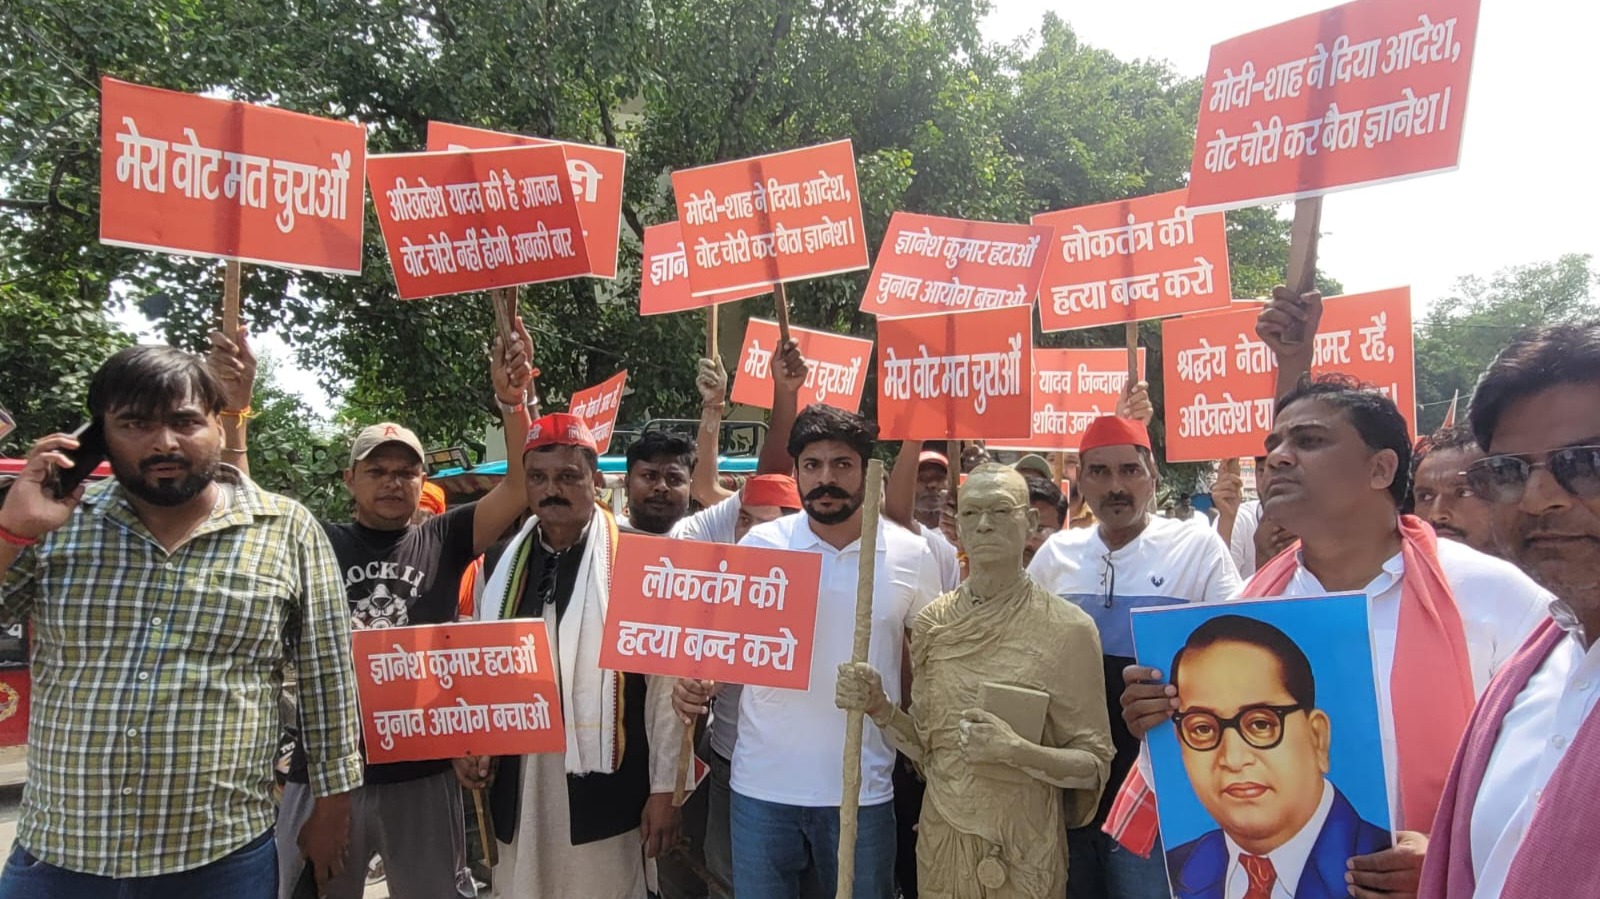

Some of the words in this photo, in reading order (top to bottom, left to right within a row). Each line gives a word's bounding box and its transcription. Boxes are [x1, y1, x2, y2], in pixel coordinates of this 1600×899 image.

[1209, 60, 1307, 113] मोदी-शाह
[1306, 42, 1328, 89] ने
[1329, 34, 1381, 87] दिया
[1381, 14, 1460, 75] आदेश,
[1204, 129, 1240, 173] वोट
[1241, 115, 1283, 166] चोरी
[1283, 118, 1323, 158] कर
[1322, 102, 1362, 152] बैठा
[1363, 86, 1451, 148] ज्ञानेश।
[115, 116, 169, 193] मेरा
[172, 127, 222, 200] वोट
[224, 151, 270, 209] मत
[272, 149, 351, 233] चुराओं
[386, 177, 448, 221] अखिलेश
[445, 182, 485, 215] यादव
[482, 169, 507, 211] की
[502, 168, 519, 211] है
[519, 174, 562, 208] आवाज
[684, 189, 753, 226] मोदी-शाह
[753, 182, 768, 213] ने
[767, 177, 801, 212] दिया
[803, 170, 850, 207] आदेश,
[400, 236, 430, 277] वोट
[425, 231, 457, 275] चोरी
[453, 226, 483, 271] नहीं
[479, 225, 514, 269] होगी
[511, 220, 553, 264] अबकी
[549, 227, 576, 258] बार
[694, 237, 722, 269] वोट
[721, 229, 750, 264] चोरी
[751, 232, 777, 259] कर
[776, 222, 803, 255] बैठा
[803, 216, 855, 254] ज्ञानेश।
[895, 227, 945, 258] ज्ञानेश
[943, 236, 990, 269] कुमार
[987, 234, 1040, 267] हटाओं
[1060, 213, 1154, 263] लोकतंत्र
[1157, 205, 1195, 247] की
[650, 242, 689, 286] ज्ञाने
[876, 272, 922, 304] चुनाव
[920, 276, 975, 308] आयोग
[1051, 280, 1107, 315] हत्या
[1109, 273, 1160, 306] बन्द
[1163, 256, 1214, 298] करो
[1358, 311, 1395, 364] रहें,
[744, 339, 772, 379] मेरा
[804, 358, 820, 389] त
[815, 356, 861, 401] चुराओं
[884, 347, 911, 400] मेरा
[913, 344, 941, 399] वोट
[941, 354, 970, 398] मत
[971, 332, 1022, 415] चुराओं
[1039, 370, 1072, 394] यादव
[1077, 363, 1128, 394] जिन्दाबा
[1033, 403, 1068, 434] शक्ति
[1178, 392, 1252, 438] अखिलेश
[642, 556, 746, 606] लोकतंत्र
[748, 566, 789, 611] की
[368, 644, 427, 685] ज्ञानेश
[426, 648, 483, 689] कुमार
[481, 633, 538, 677] हटाओं
[616, 620, 682, 659] हत्या
[683, 626, 740, 665] बन्द
[743, 627, 798, 671] करो
[373, 708, 426, 751] चुनाव
[428, 697, 491, 736] आयोग
[491, 693, 551, 732] बचाओ
